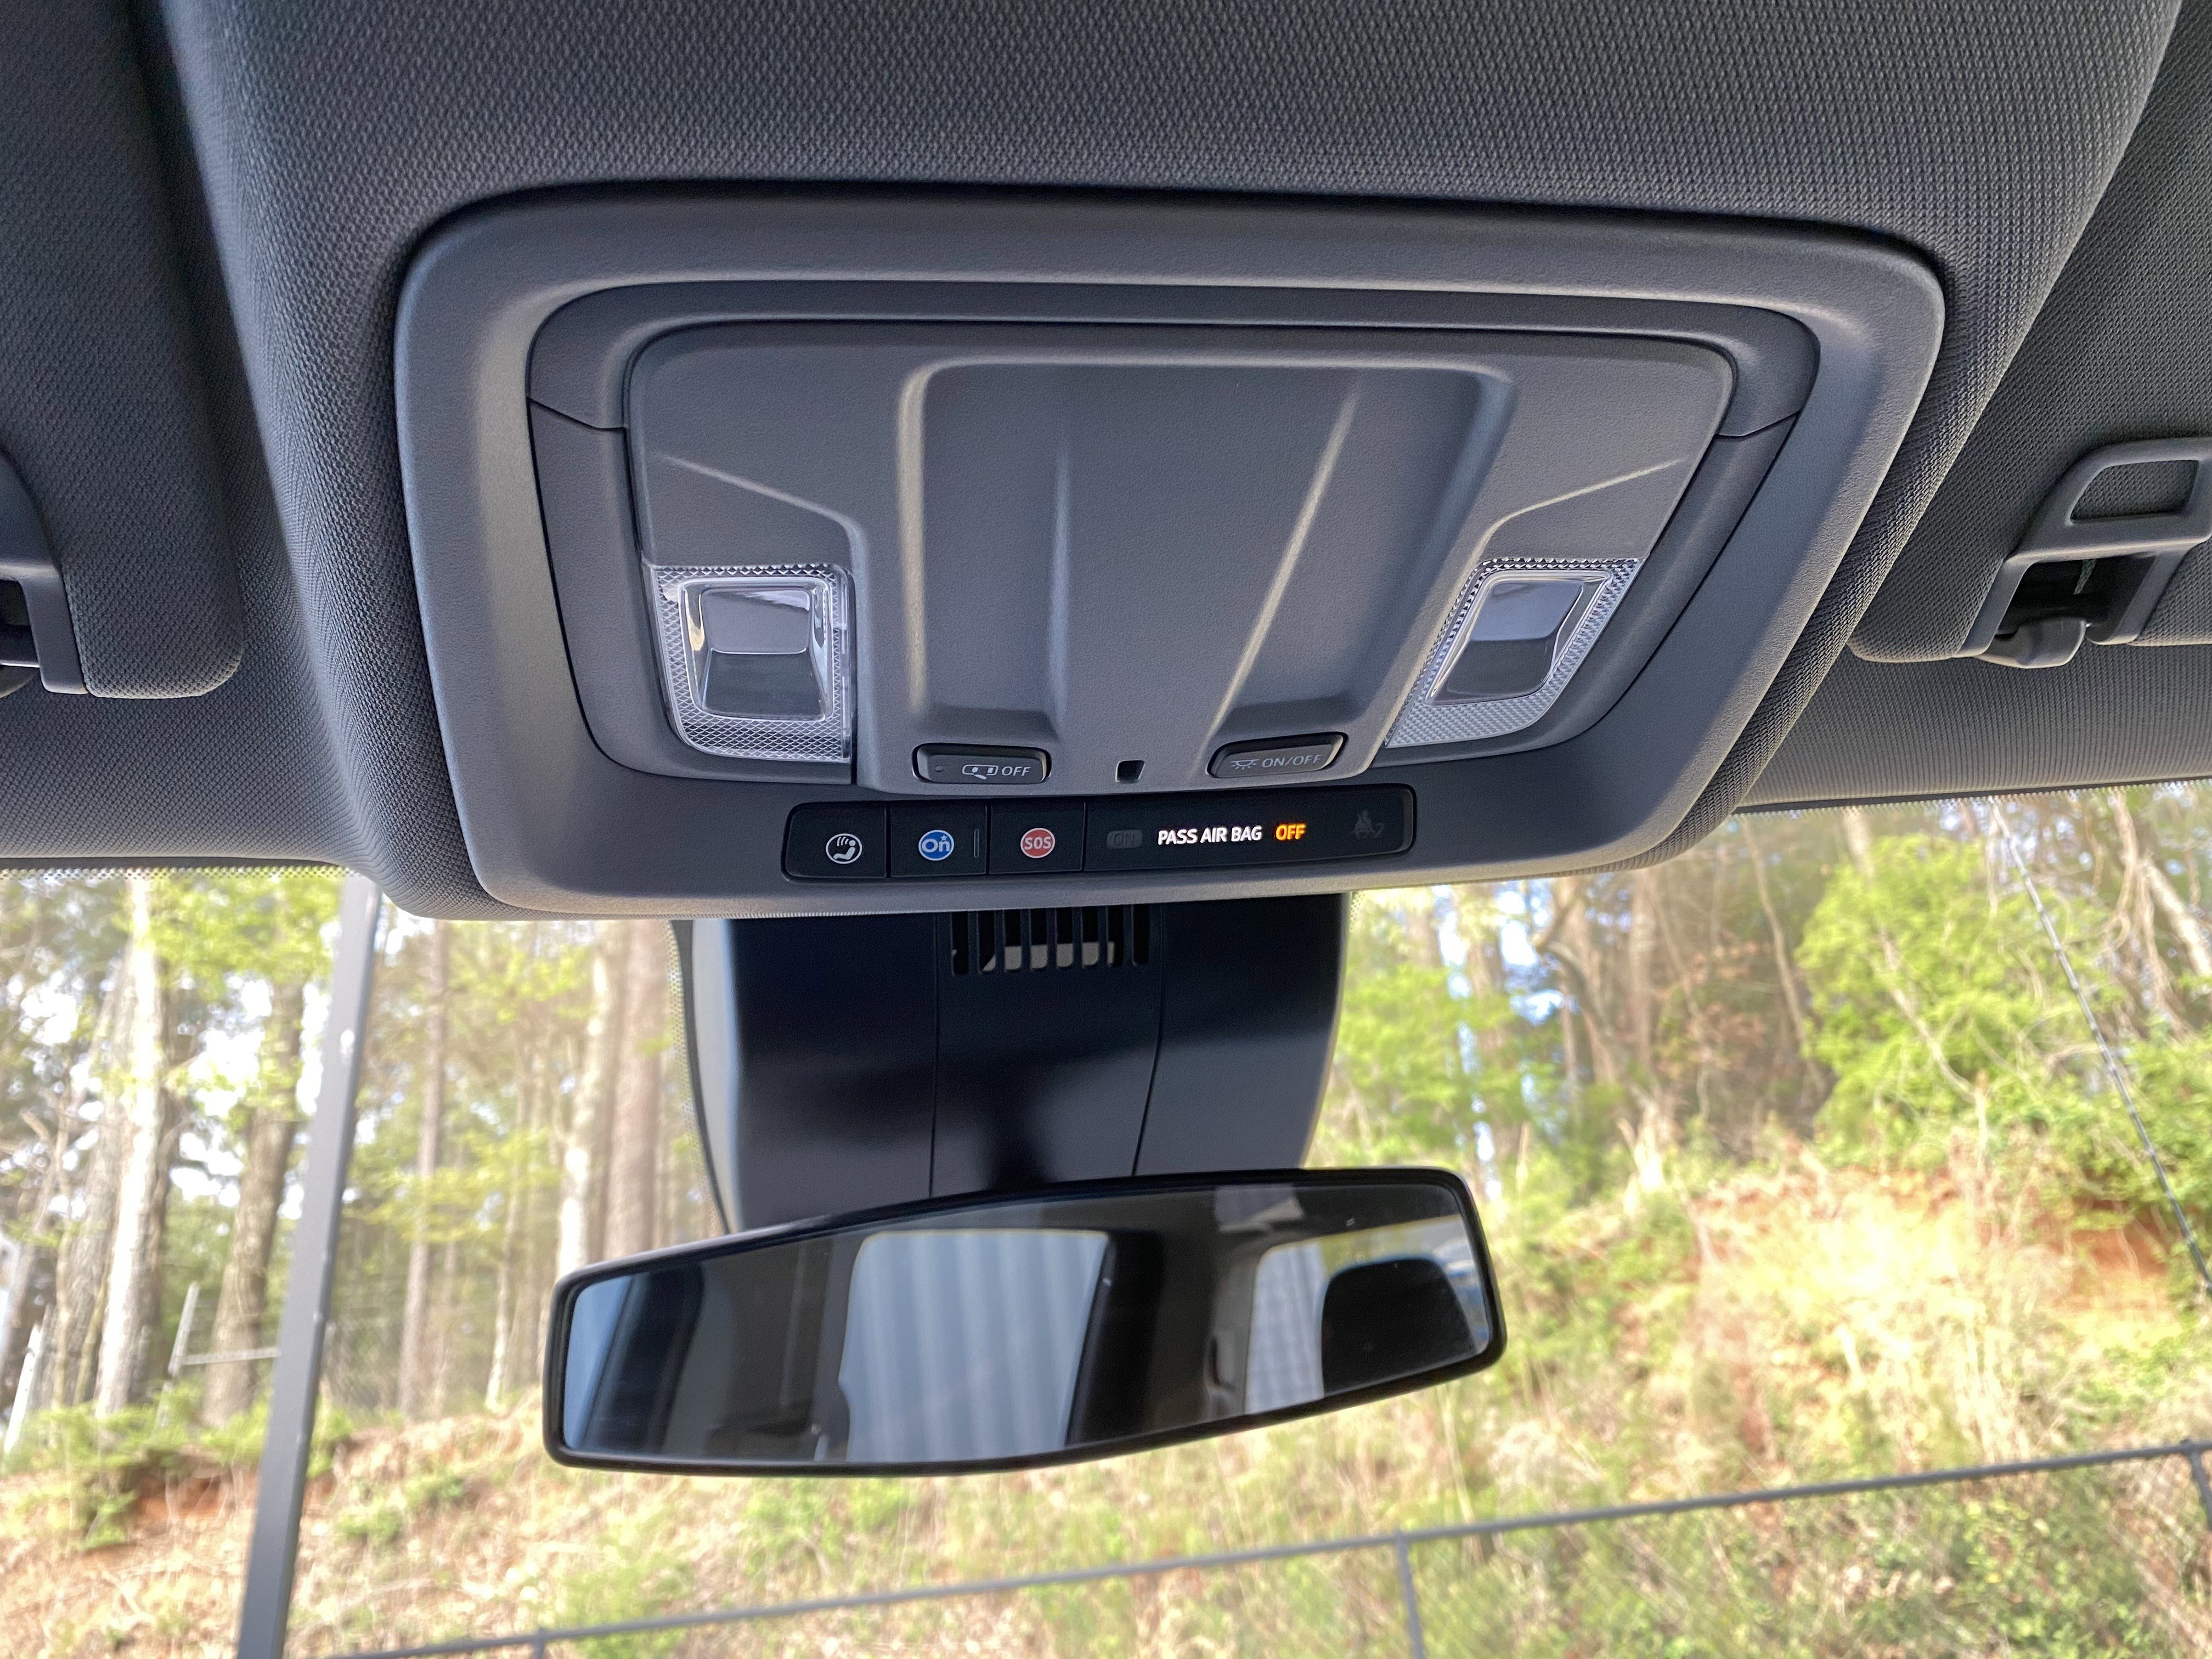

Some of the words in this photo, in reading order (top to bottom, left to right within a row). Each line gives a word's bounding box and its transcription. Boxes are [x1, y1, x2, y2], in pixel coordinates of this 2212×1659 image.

[1262, 754, 1321, 768] ON/OFF
[1001, 766, 1031, 776] OFF
[1114, 833, 1135, 847] ON
[1158, 829, 1197, 845] PASS
[1200, 827, 1227, 843] AIR
[1231, 825, 1262, 842] BAG
[1276, 824, 1306, 840] OFF
[922, 835, 950, 853] On
[1024, 837, 1051, 850] SOS
